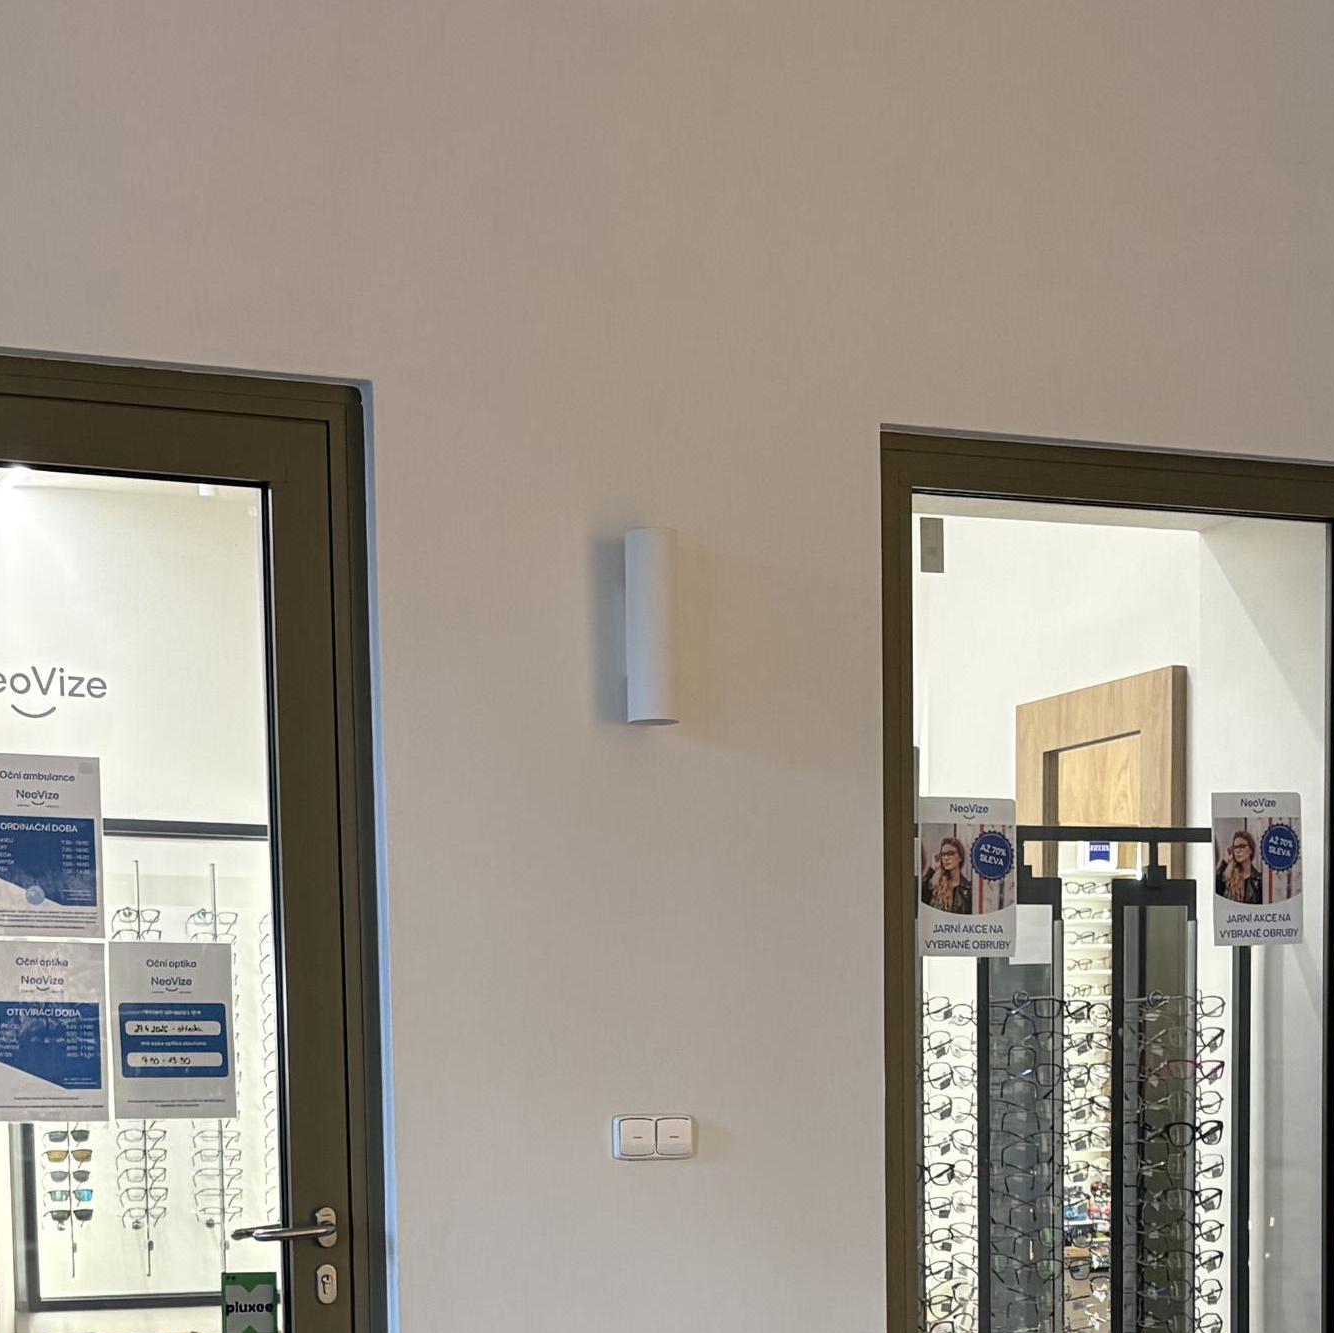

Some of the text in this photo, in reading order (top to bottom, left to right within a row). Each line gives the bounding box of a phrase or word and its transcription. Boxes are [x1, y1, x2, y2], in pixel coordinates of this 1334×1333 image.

[0, 771, 75, 782] Oční ambulance
[16, 790, 59, 800] NeoVize
[1241, 799, 1276, 808] NeoVize
[950, 804, 988, 813] NeoVize
[0, 823, 50, 831] ORDINAČNÍ
[1269, 846, 1291, 856] SLEVA
[979, 853, 1003, 866] SLEVA
[1227, 913, 1291, 923] JARNÍ AKCE NA
[933, 924, 1003, 933] JARNÍ AKCE NA
[1220, 928, 1298, 938] VYBRANÉ OBRUBY
[925, 939, 1010, 949] VYBRANÉ OBRUBY
[16, 957, 68, 966] Oční optika
[146, 959, 196, 968] Oční optika
[21, 976, 64, 985] NeoVize
[151, 977, 192, 986] NeoVize
[55, 1009, 80, 1017] DOBA
[226, 1302, 274, 1316] pluxee
